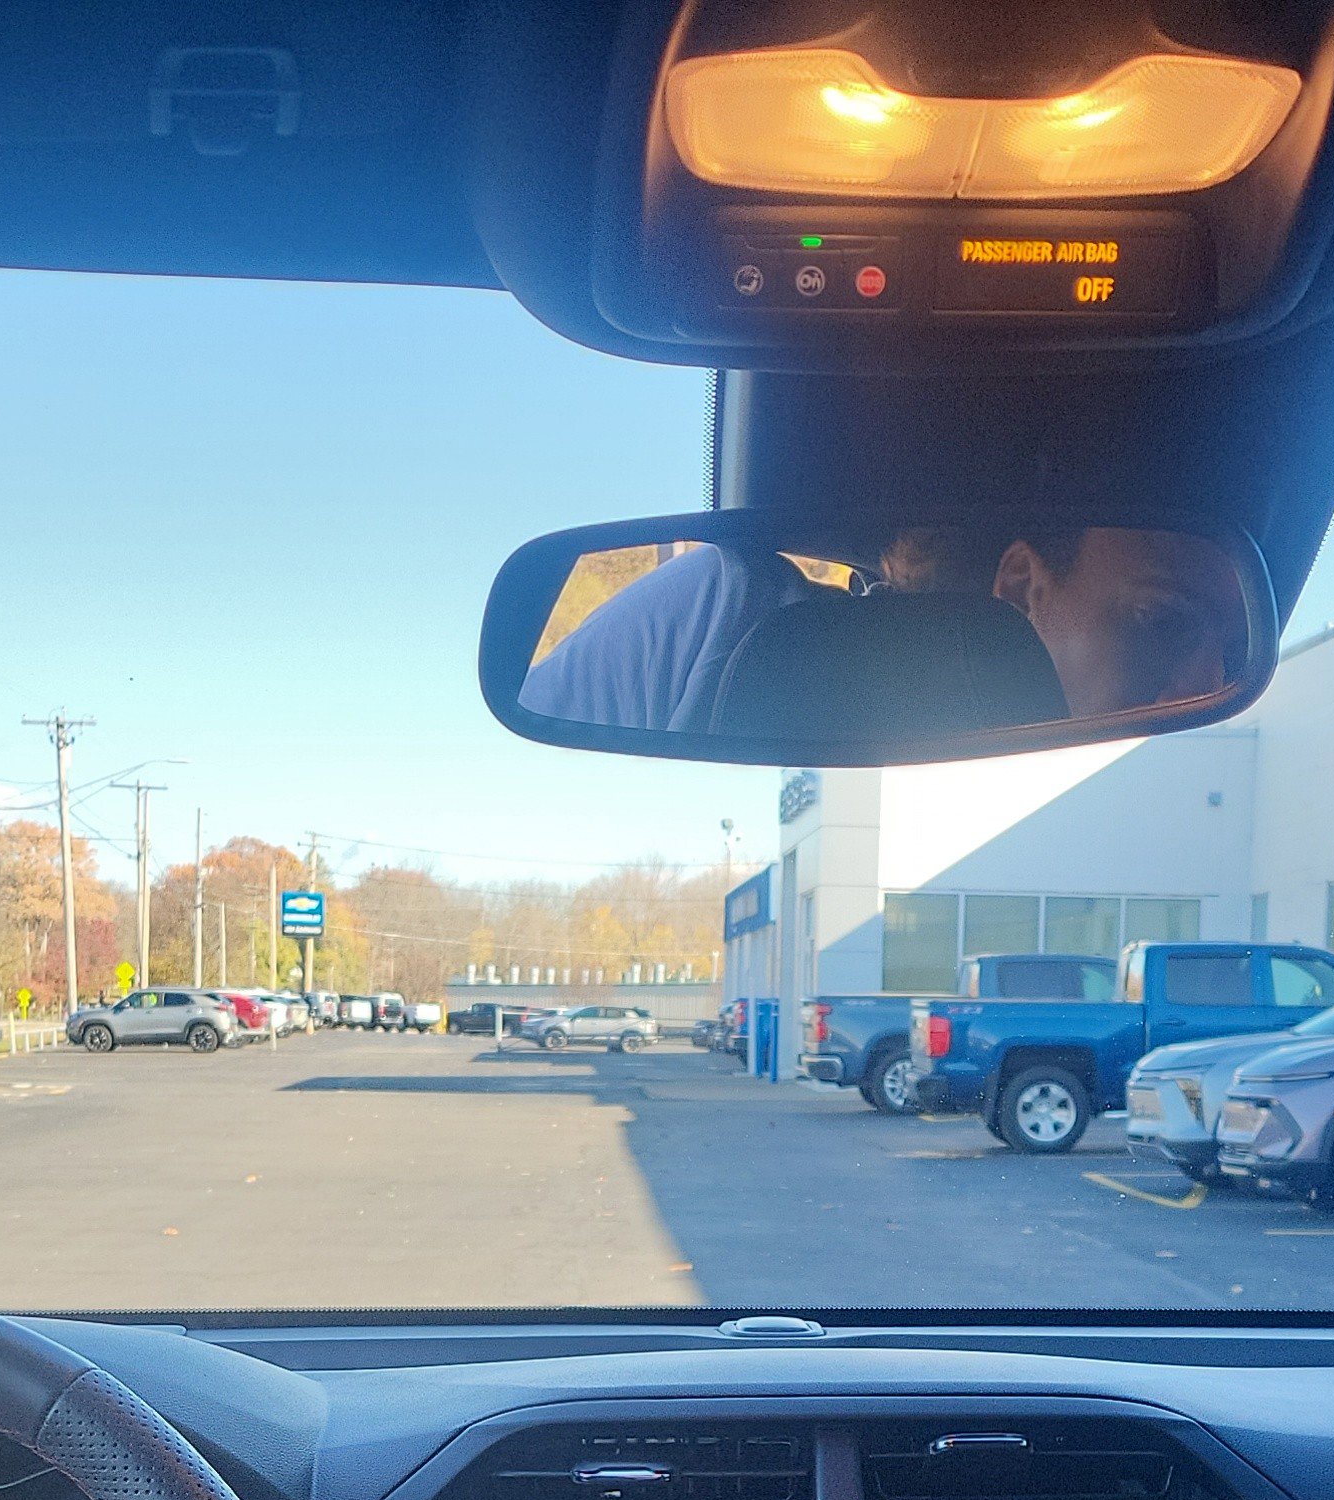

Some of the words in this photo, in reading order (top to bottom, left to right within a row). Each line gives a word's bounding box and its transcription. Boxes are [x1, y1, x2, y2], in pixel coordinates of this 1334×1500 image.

[962, 240, 1053, 264] PASSENGER
[1056, 240, 1083, 263] AIR
[1085, 240, 1118, 263] BAG
[1077, 277, 1115, 302] OFF
